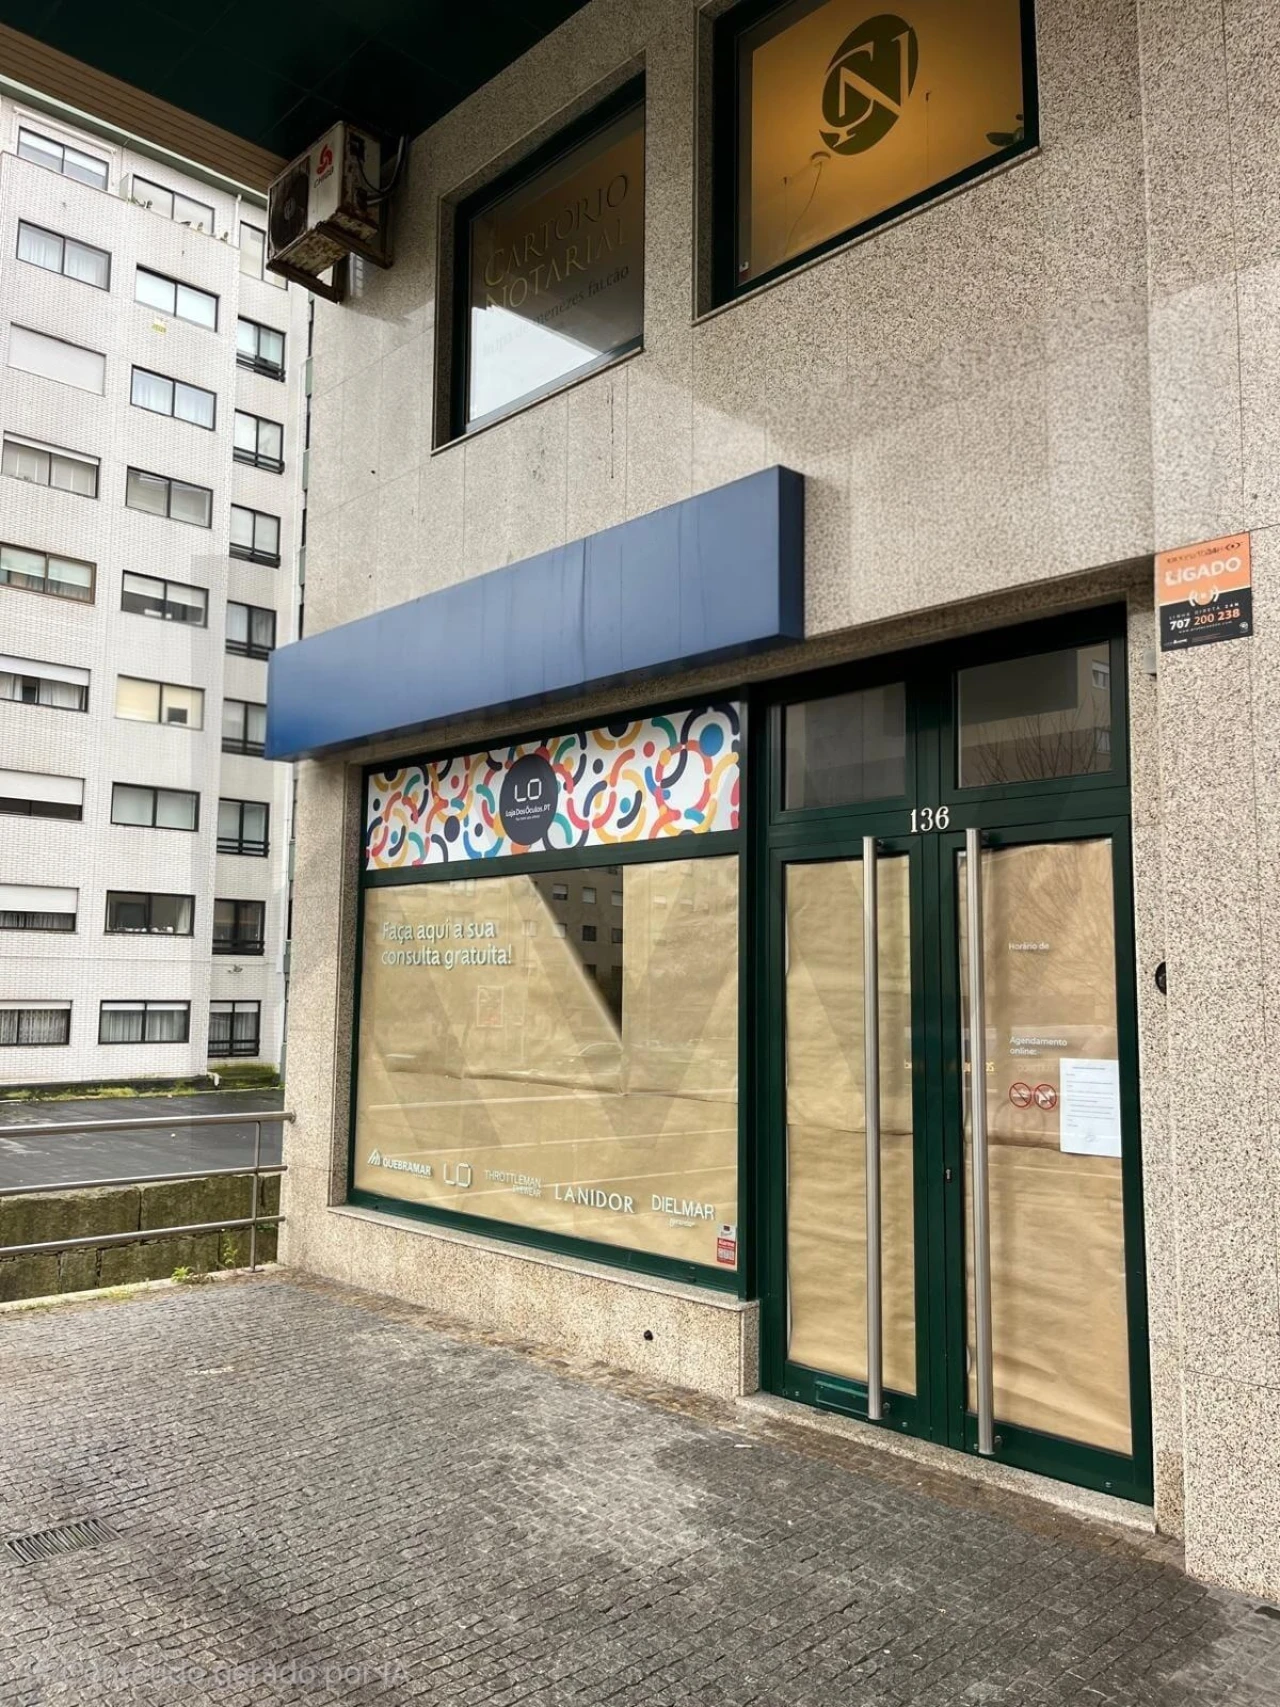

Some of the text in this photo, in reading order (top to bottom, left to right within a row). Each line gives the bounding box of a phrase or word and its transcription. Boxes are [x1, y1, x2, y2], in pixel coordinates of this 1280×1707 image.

[485, 217, 626, 308] NOTARIAL
[1164, 556, 1242, 587] LIGADO
[1169, 618, 1191, 631] 707
[1193, 613, 1215, 626] 200
[1217, 608, 1241, 621] 238
[910, 805, 950, 833] 136
[382, 917, 496, 945] Faça aqui a sua
[381, 943, 512, 970] consulta gratuita!
[1038, 941, 1050, 951] de
[1009, 1036, 1068, 1047] Agendamento
[1009, 1047, 1037, 1056] online:
[382, 1157, 433, 1177] QUEBRAMAR
[485, 1169, 542, 1188] THROTTLEMAN
[554, 1183, 635, 1214] LANIDOR
[651, 1193, 715, 1221] DIELMAR
